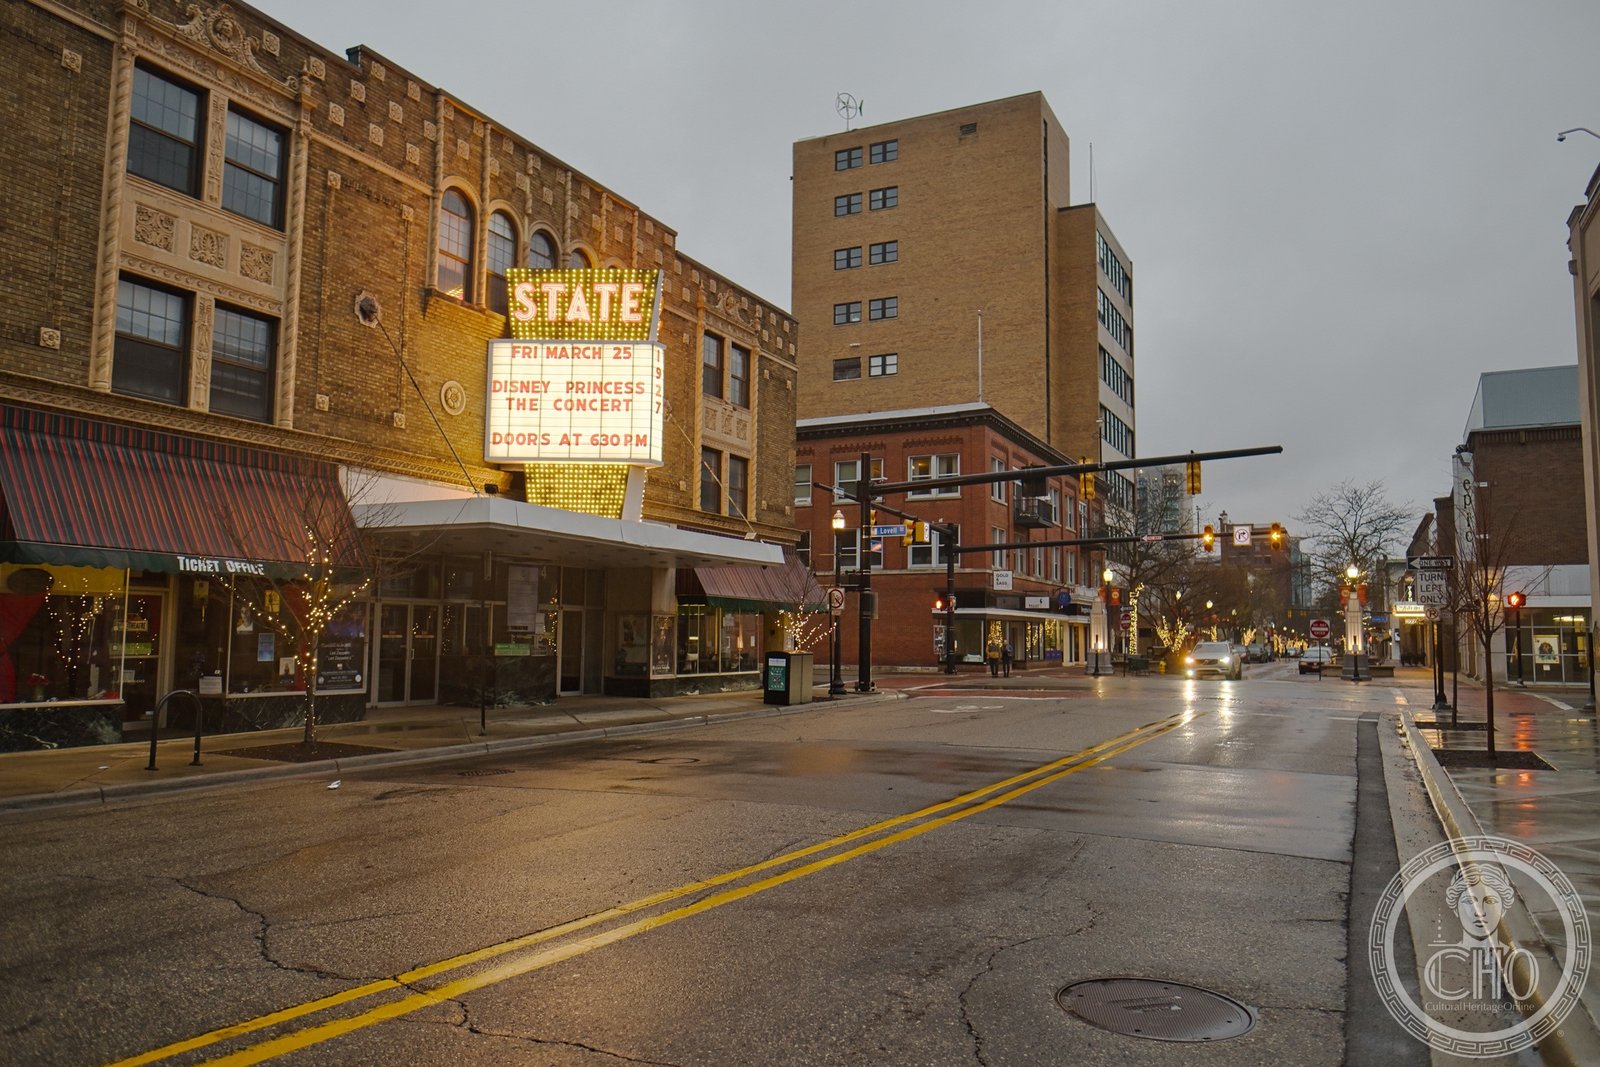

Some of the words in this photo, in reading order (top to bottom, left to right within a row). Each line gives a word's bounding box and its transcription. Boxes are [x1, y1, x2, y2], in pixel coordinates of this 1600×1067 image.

[513, 282, 643, 323] STATE
[511, 346, 538, 359] FRI
[546, 346, 602, 359] MARCH
[613, 346, 632, 359] 25
[492, 380, 551, 394] DISNEY
[566, 381, 645, 395] PRINCESS
[505, 397, 538, 411] THE
[553, 398, 633, 412] CONCERT
[492, 432, 551, 446] DOORS
[559, 433, 582, 446] AT
[1463, 479, 1473, 542] epic
[880, 527, 898, 535] Lovell
[177, 556, 220, 573] TICKET
[225, 560, 265, 576] OFFICE
[1420, 573, 1443, 581] TURN
[1420, 595, 1444, 603] ONLY
